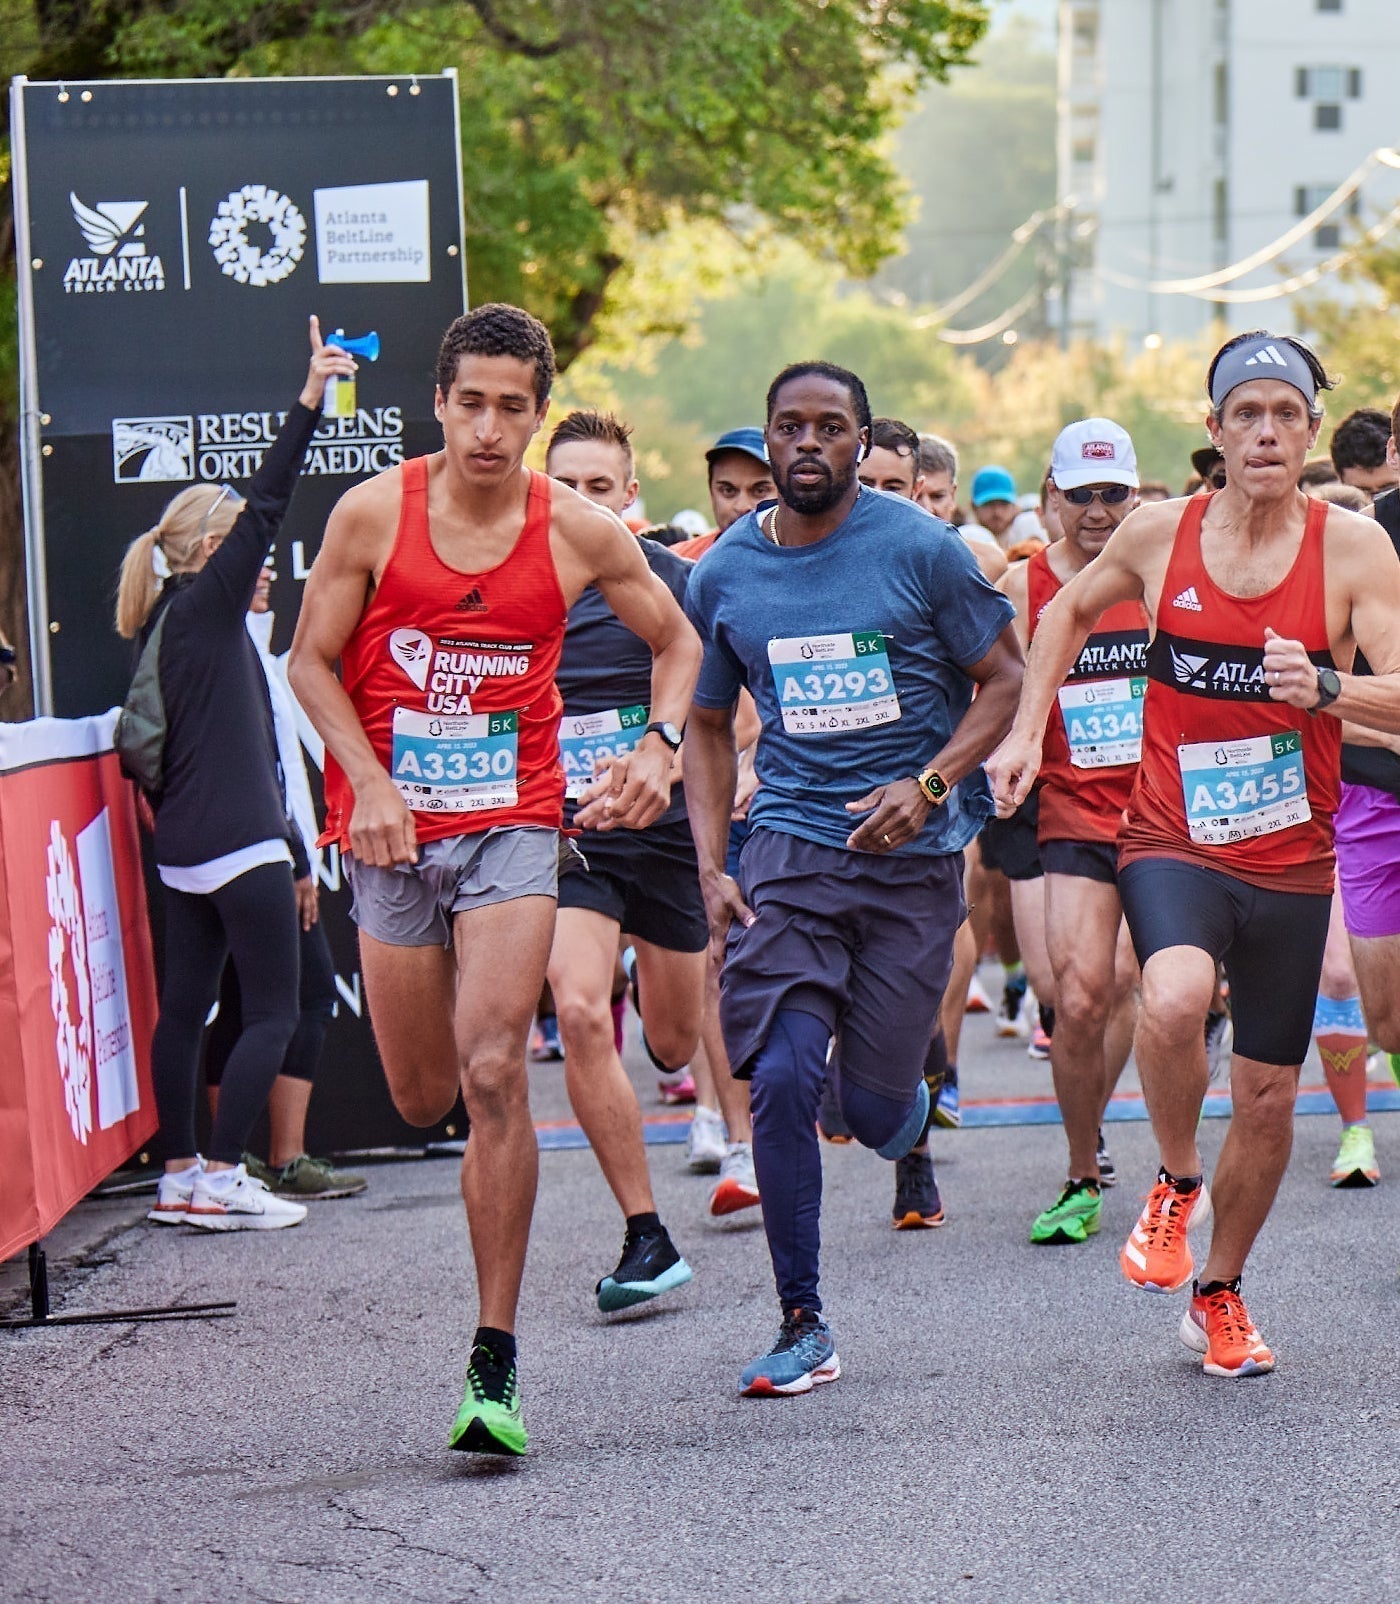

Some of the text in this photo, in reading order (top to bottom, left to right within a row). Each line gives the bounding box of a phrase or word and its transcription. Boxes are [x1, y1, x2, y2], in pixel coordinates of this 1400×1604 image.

[326, 211, 387, 224] Atlanta
[326, 229, 393, 244] BeltLine
[327, 247, 423, 265] Partnership
[64, 256, 165, 282] ATLANTA
[64, 279, 165, 293] TRACK CLUB
[199, 406, 404, 444] RESUGENS
[1173, 599, 1202, 612] adidas
[434, 652, 529, 676] RUNNING
[1079, 660, 1147, 673] TRACK CLU
[1213, 662, 1265, 684] ATLA
[431, 672, 483, 694] CITY
[782, 668, 889, 701] A3293
[1213, 681, 1262, 694] TRACK
[427, 693, 473, 715] USA
[1070, 712, 1143, 741] A334
[396, 748, 514, 780] A3330
[1191, 767, 1300, 813] A3455
